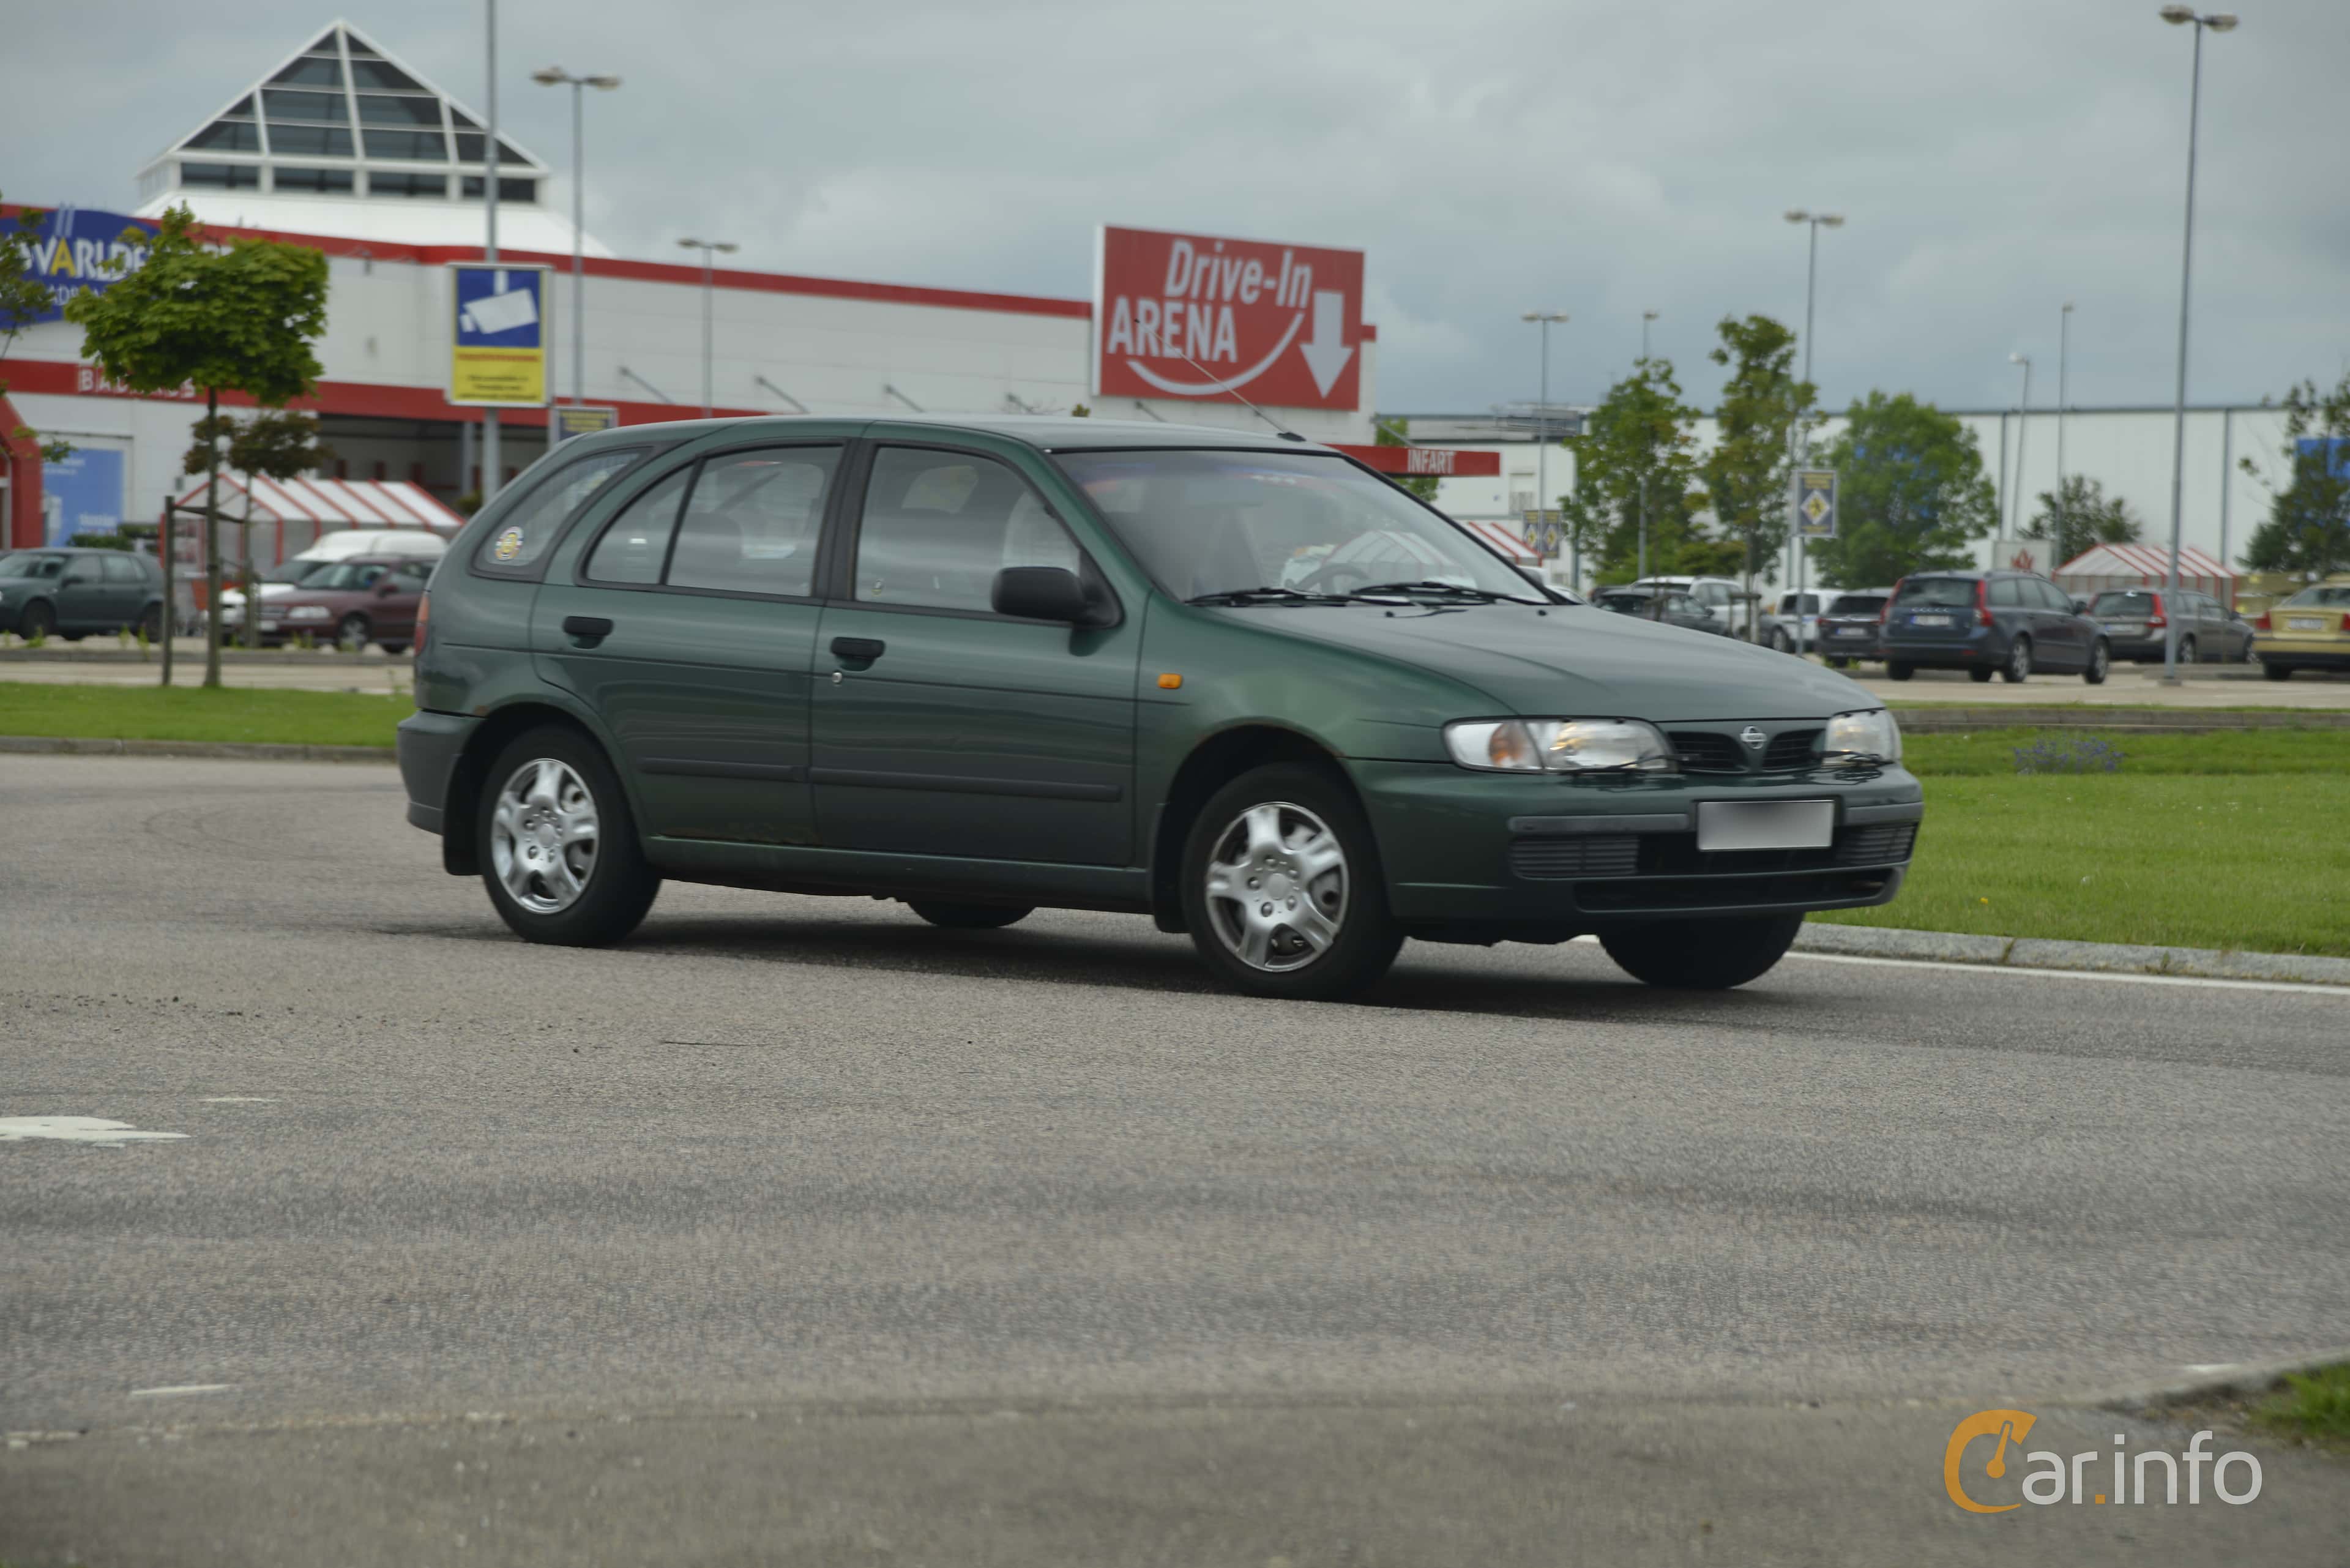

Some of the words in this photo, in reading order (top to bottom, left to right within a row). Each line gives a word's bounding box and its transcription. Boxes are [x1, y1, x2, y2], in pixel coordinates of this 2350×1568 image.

[1165, 239, 1312, 308] Drive-In
[1106, 295, 1237, 363] ARENA
[1408, 449, 1456, 474] INFART
